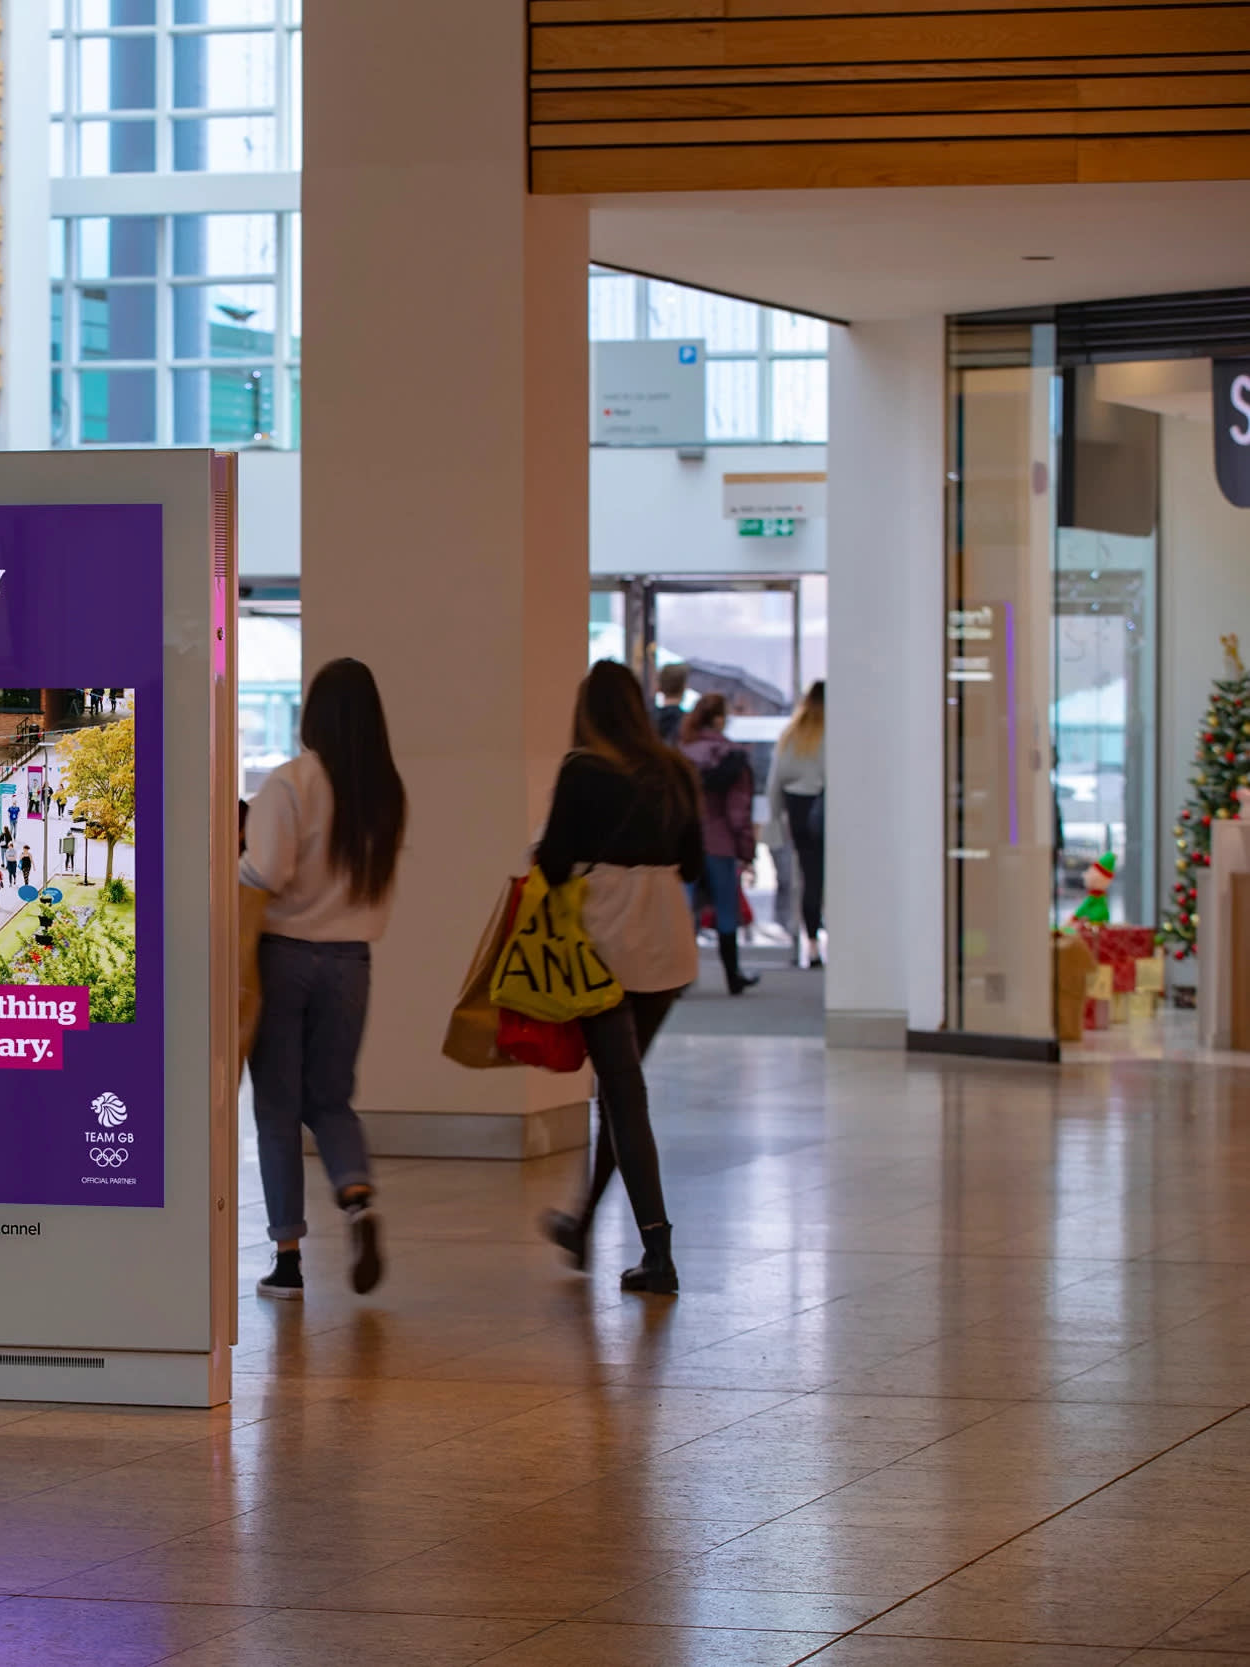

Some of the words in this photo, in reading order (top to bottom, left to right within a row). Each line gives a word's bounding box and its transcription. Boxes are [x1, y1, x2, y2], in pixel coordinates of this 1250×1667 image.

[84, 1132, 115, 1143] TEAM
[117, 1132, 135, 1144] GB
[81, 1176, 109, 1185] OFFICIAL
[109, 1177, 137, 1186] PARTNER
